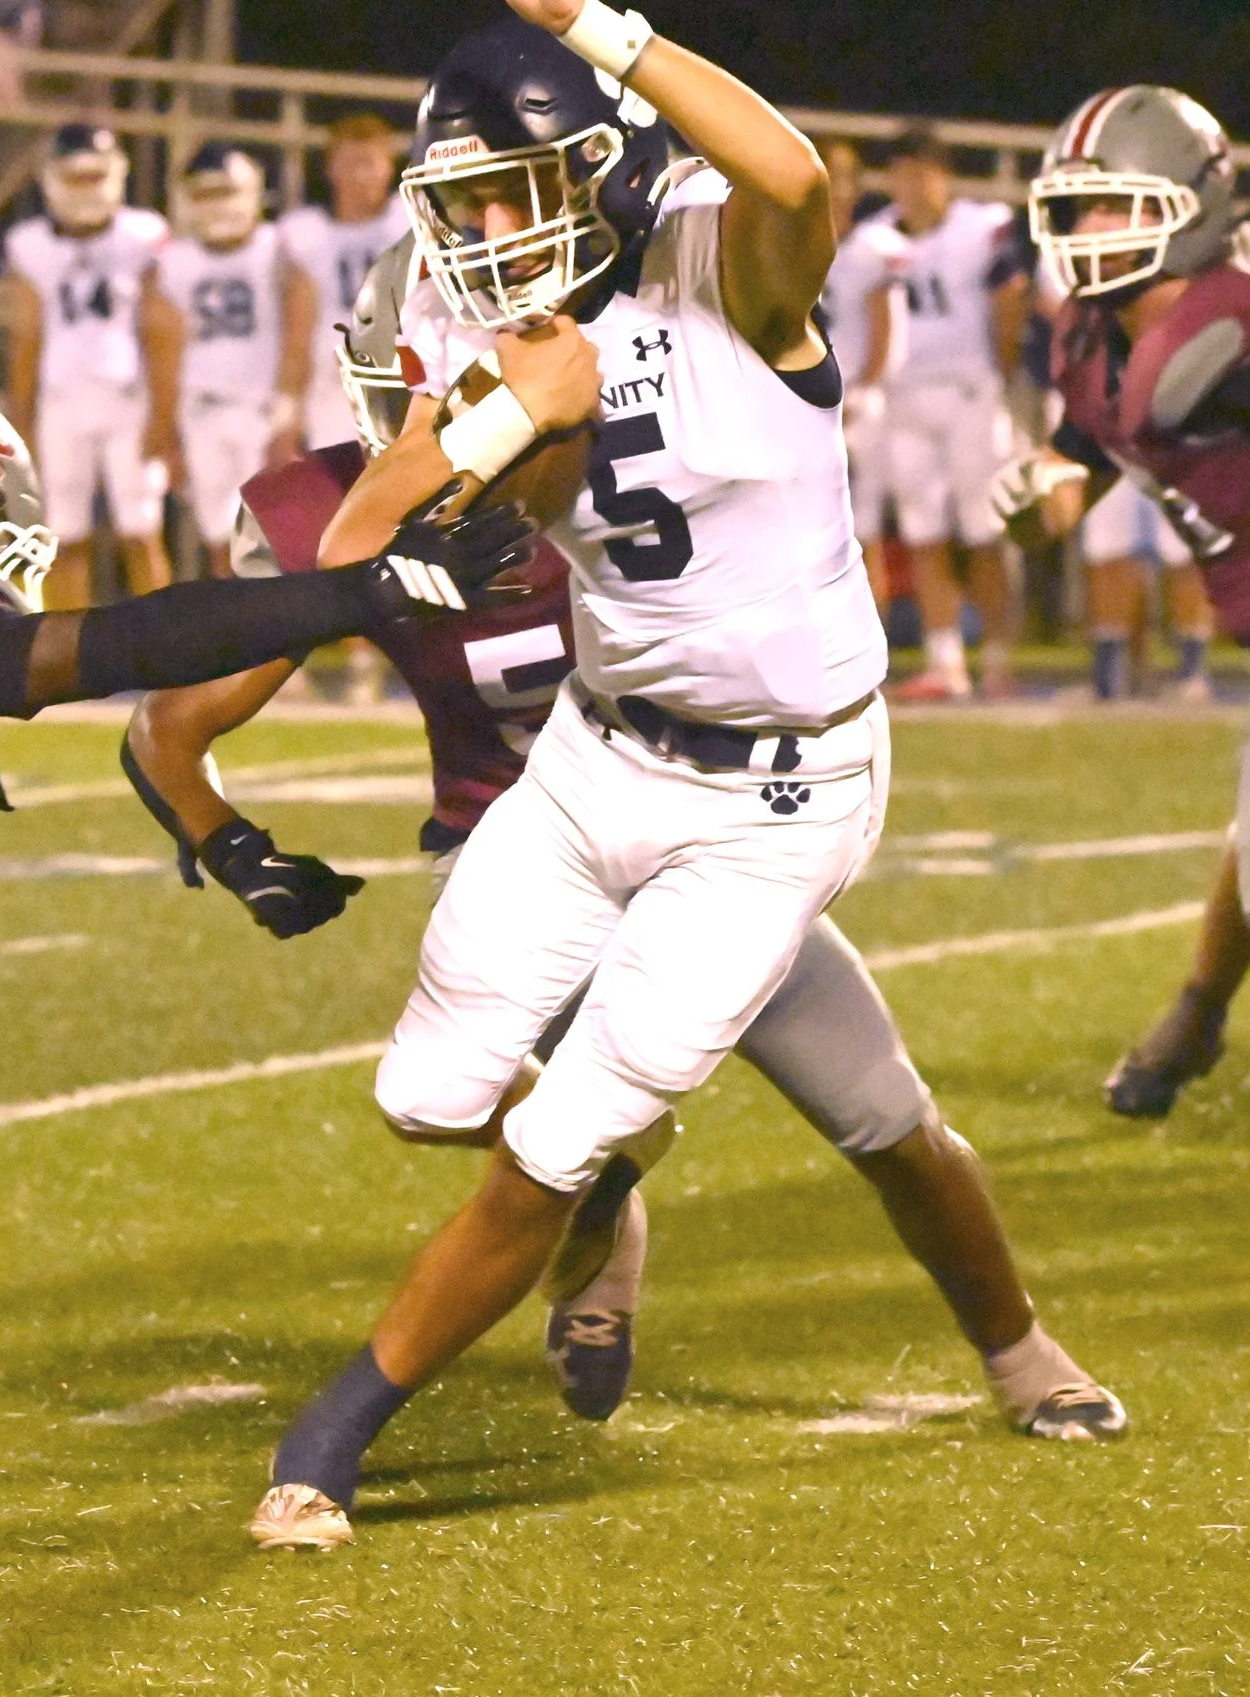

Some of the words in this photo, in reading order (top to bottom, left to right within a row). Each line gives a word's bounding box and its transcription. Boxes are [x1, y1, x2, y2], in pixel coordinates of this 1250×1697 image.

[429, 140, 479, 161] Riddell
[600, 373, 665, 409] NITY
[590, 411, 694, 583] 5
